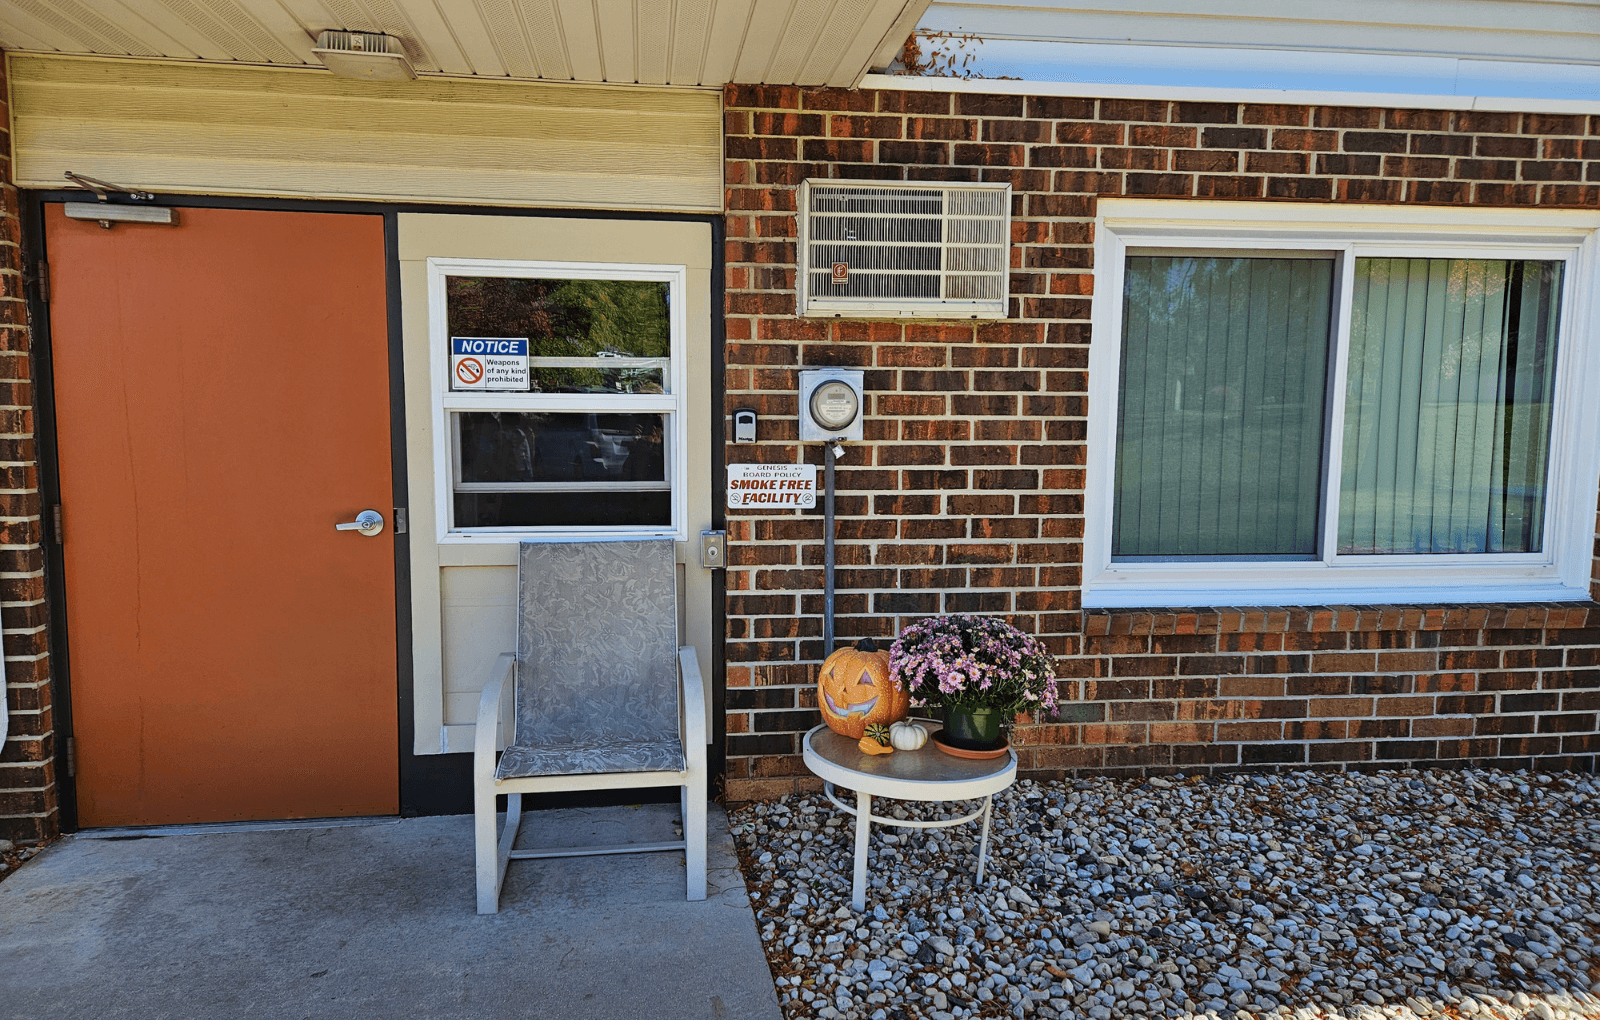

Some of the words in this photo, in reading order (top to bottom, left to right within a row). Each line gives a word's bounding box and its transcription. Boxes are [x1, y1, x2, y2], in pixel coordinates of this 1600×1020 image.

[461, 340, 520, 353] NOTICE
[730, 479, 777, 490] SMOKE
[779, 479, 813, 490] FREE
[742, 492, 802, 503] FACILITY
